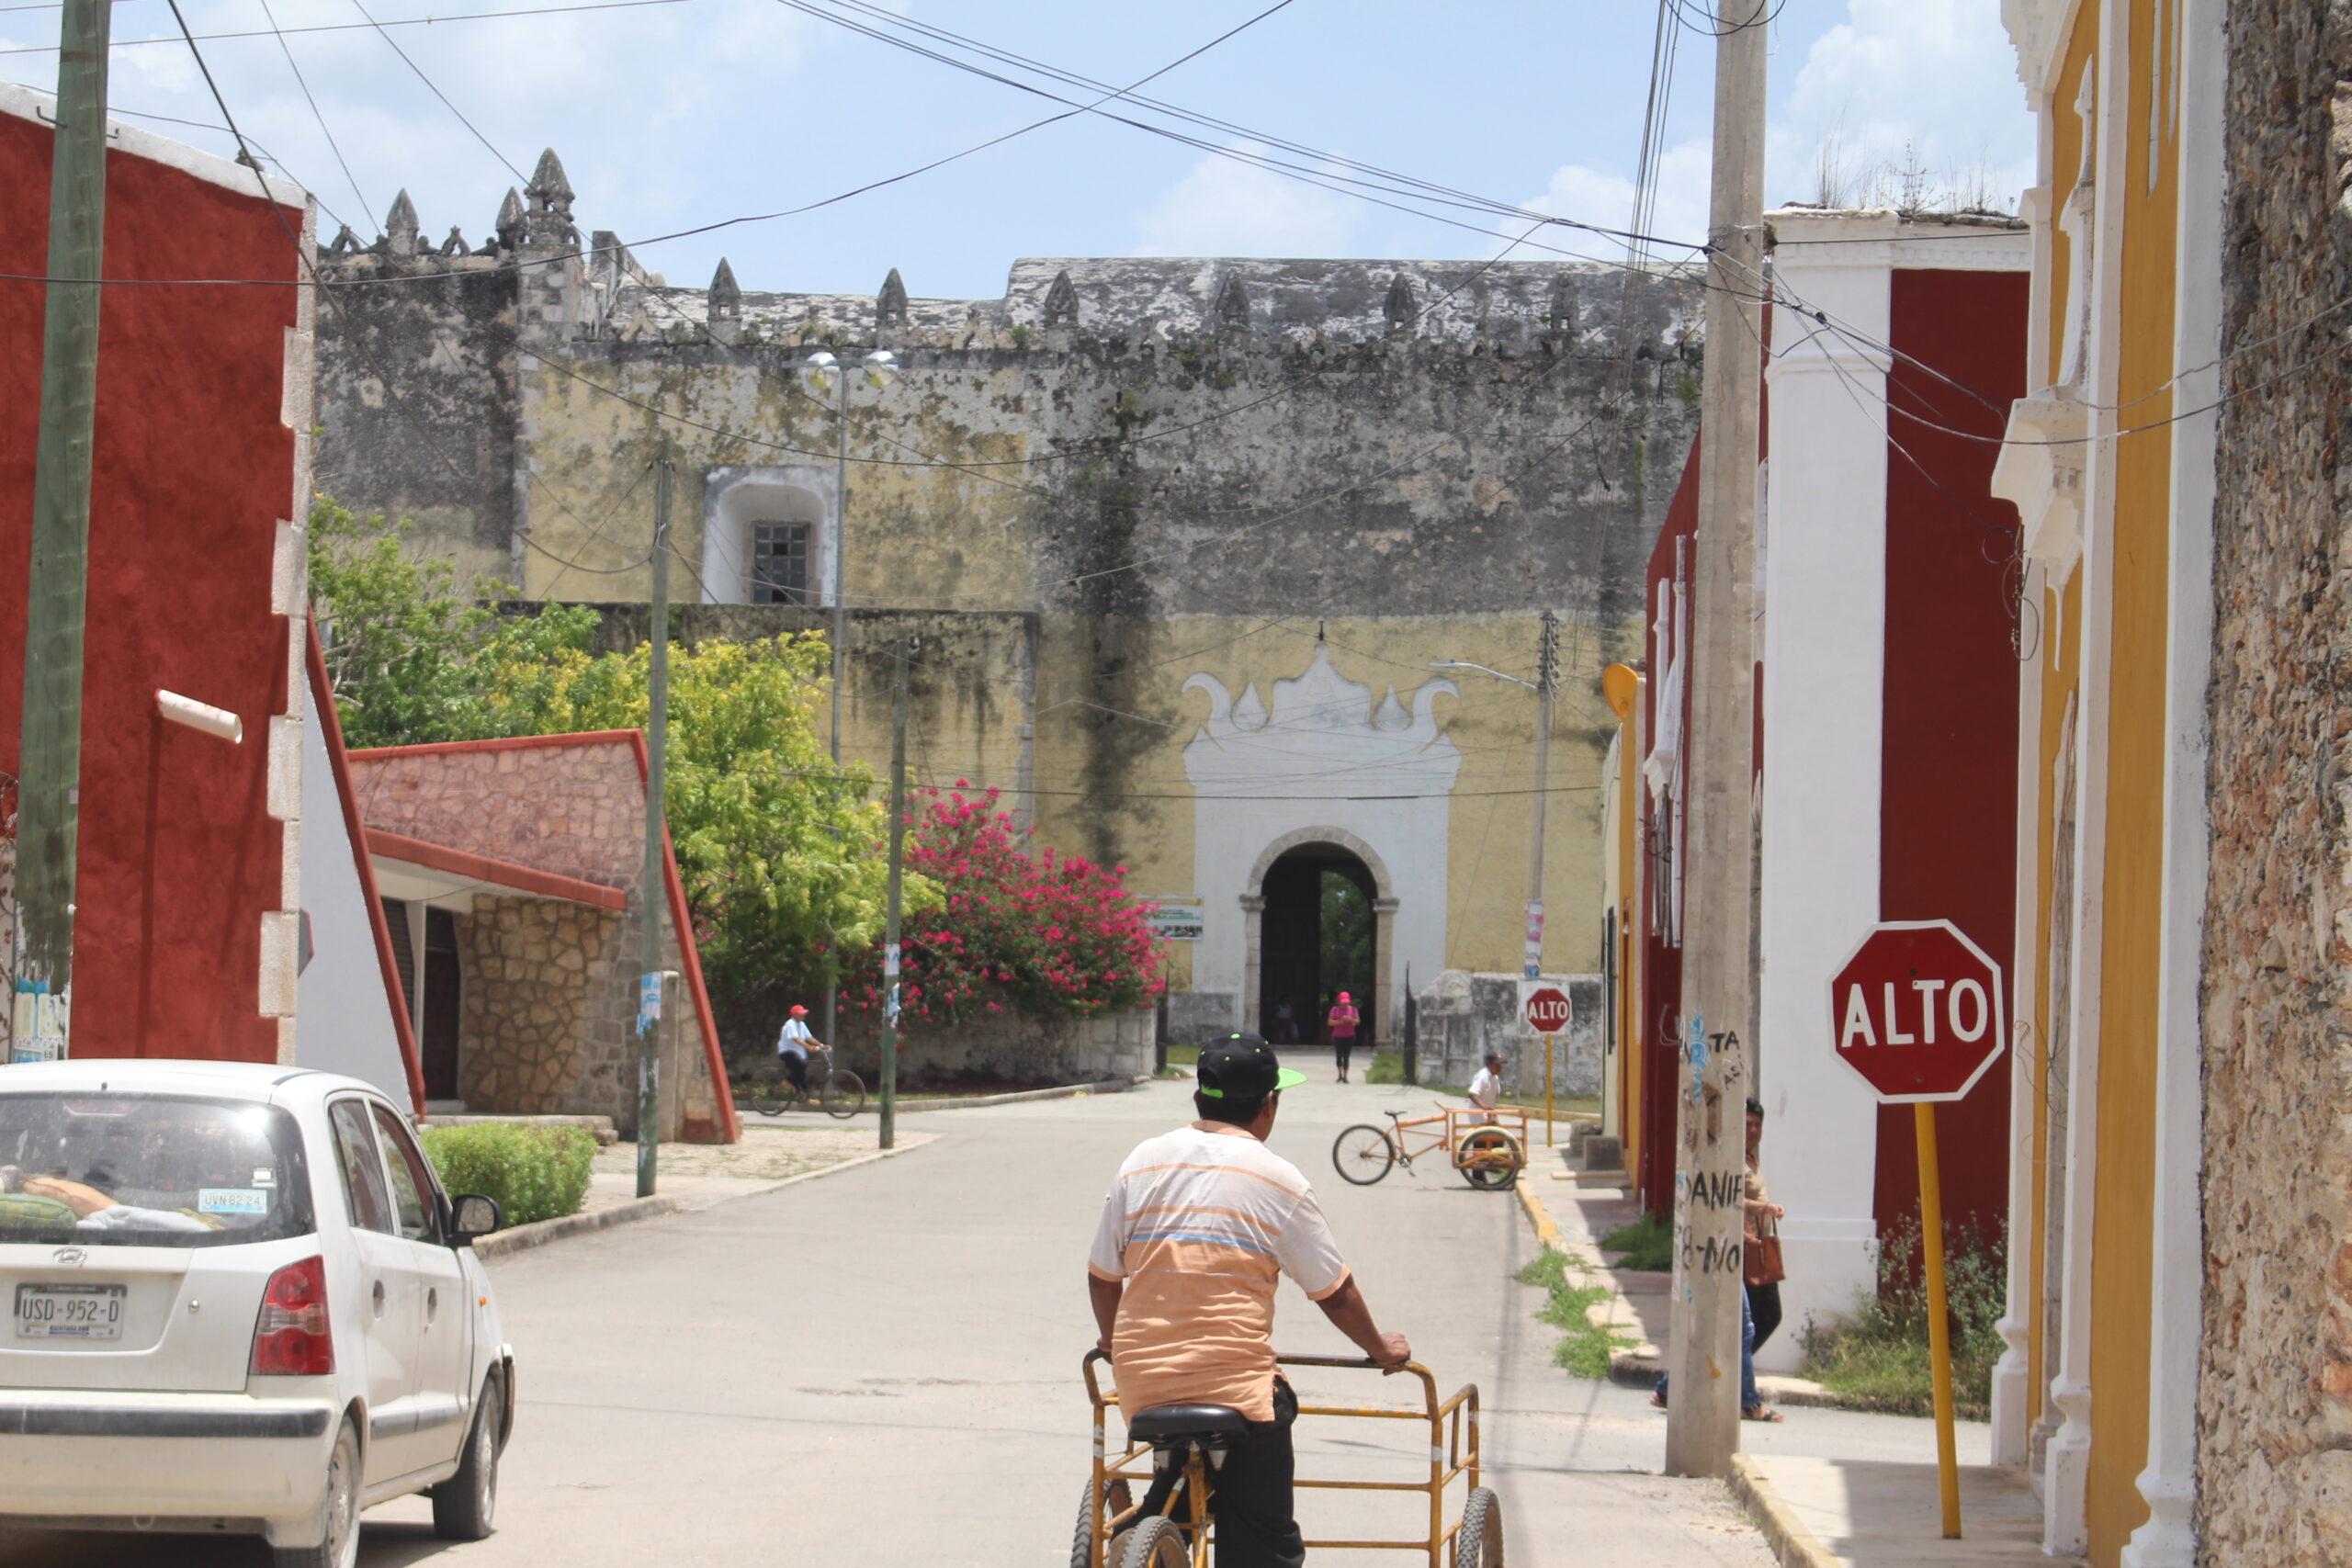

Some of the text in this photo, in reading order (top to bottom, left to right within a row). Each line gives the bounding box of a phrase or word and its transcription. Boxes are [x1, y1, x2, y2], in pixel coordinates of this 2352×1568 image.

[1528, 1001, 1569, 1020] ALTO
[1841, 978, 1988, 1047] ALTO
[22, 1298, 119, 1323] USD-952-D
